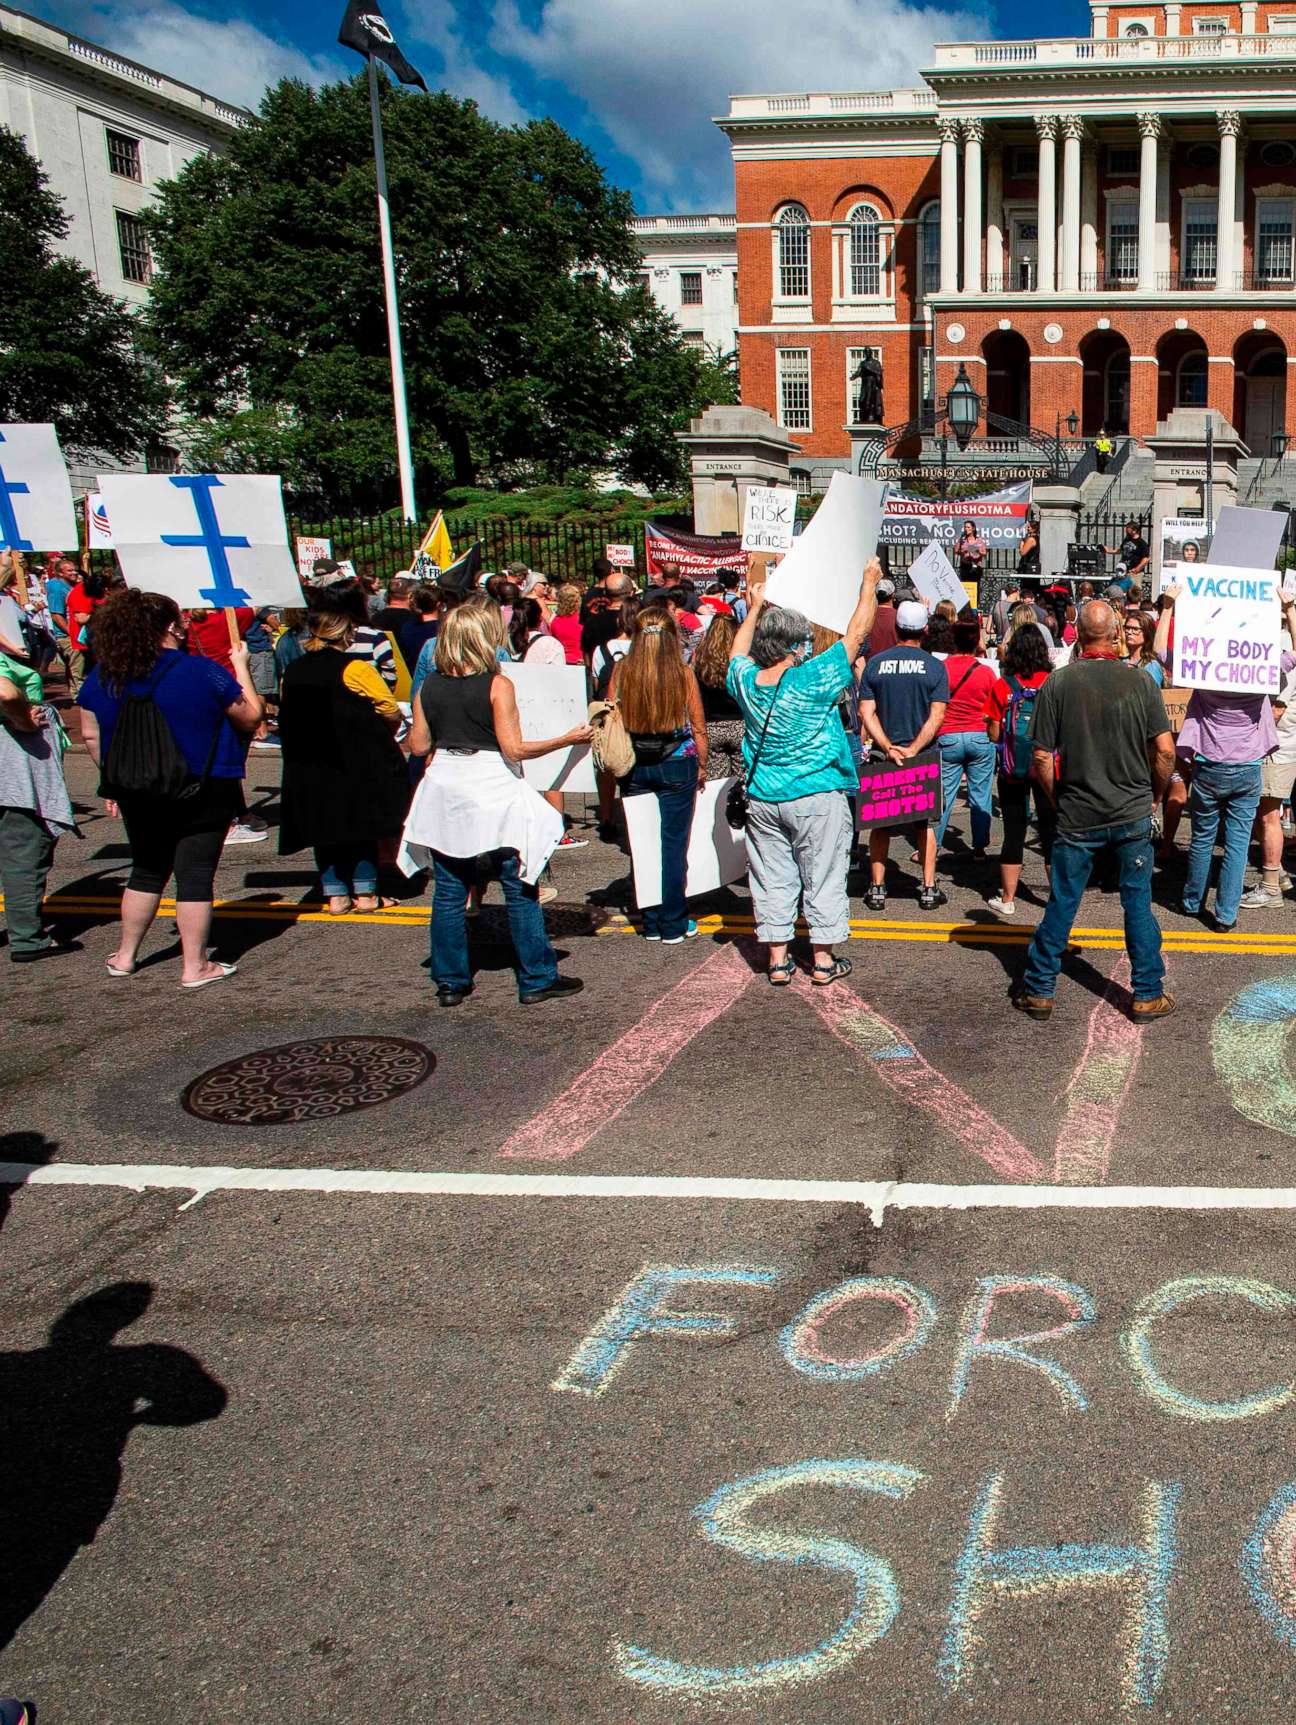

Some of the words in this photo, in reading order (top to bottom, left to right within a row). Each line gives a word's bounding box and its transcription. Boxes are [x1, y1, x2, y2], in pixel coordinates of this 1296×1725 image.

[1010, 469, 1048, 479] HOUSE
[1170, 468, 1207, 476] ENTRANC
[751, 505, 791, 523] RISK
[883, 503, 1013, 515] ANDATORYFLUSHOTMA
[746, 534, 789, 548] CHOICE
[933, 528, 956, 538] NO
[1186, 576, 1273, 602] VACCINE
[1181, 636, 1215, 657] MY
[1227, 640, 1274, 661] BODY
[878, 660, 898, 674] JUST
[899, 660, 926, 675] MOVE.
[1181, 659, 1211, 681] MY
[1214, 661, 1279, 686] CHOICE
[860, 763, 940, 792] PARENTS
[872, 787, 897, 801] Call
[901, 784, 924, 796] The
[861, 791, 936, 821] SHOTS!
